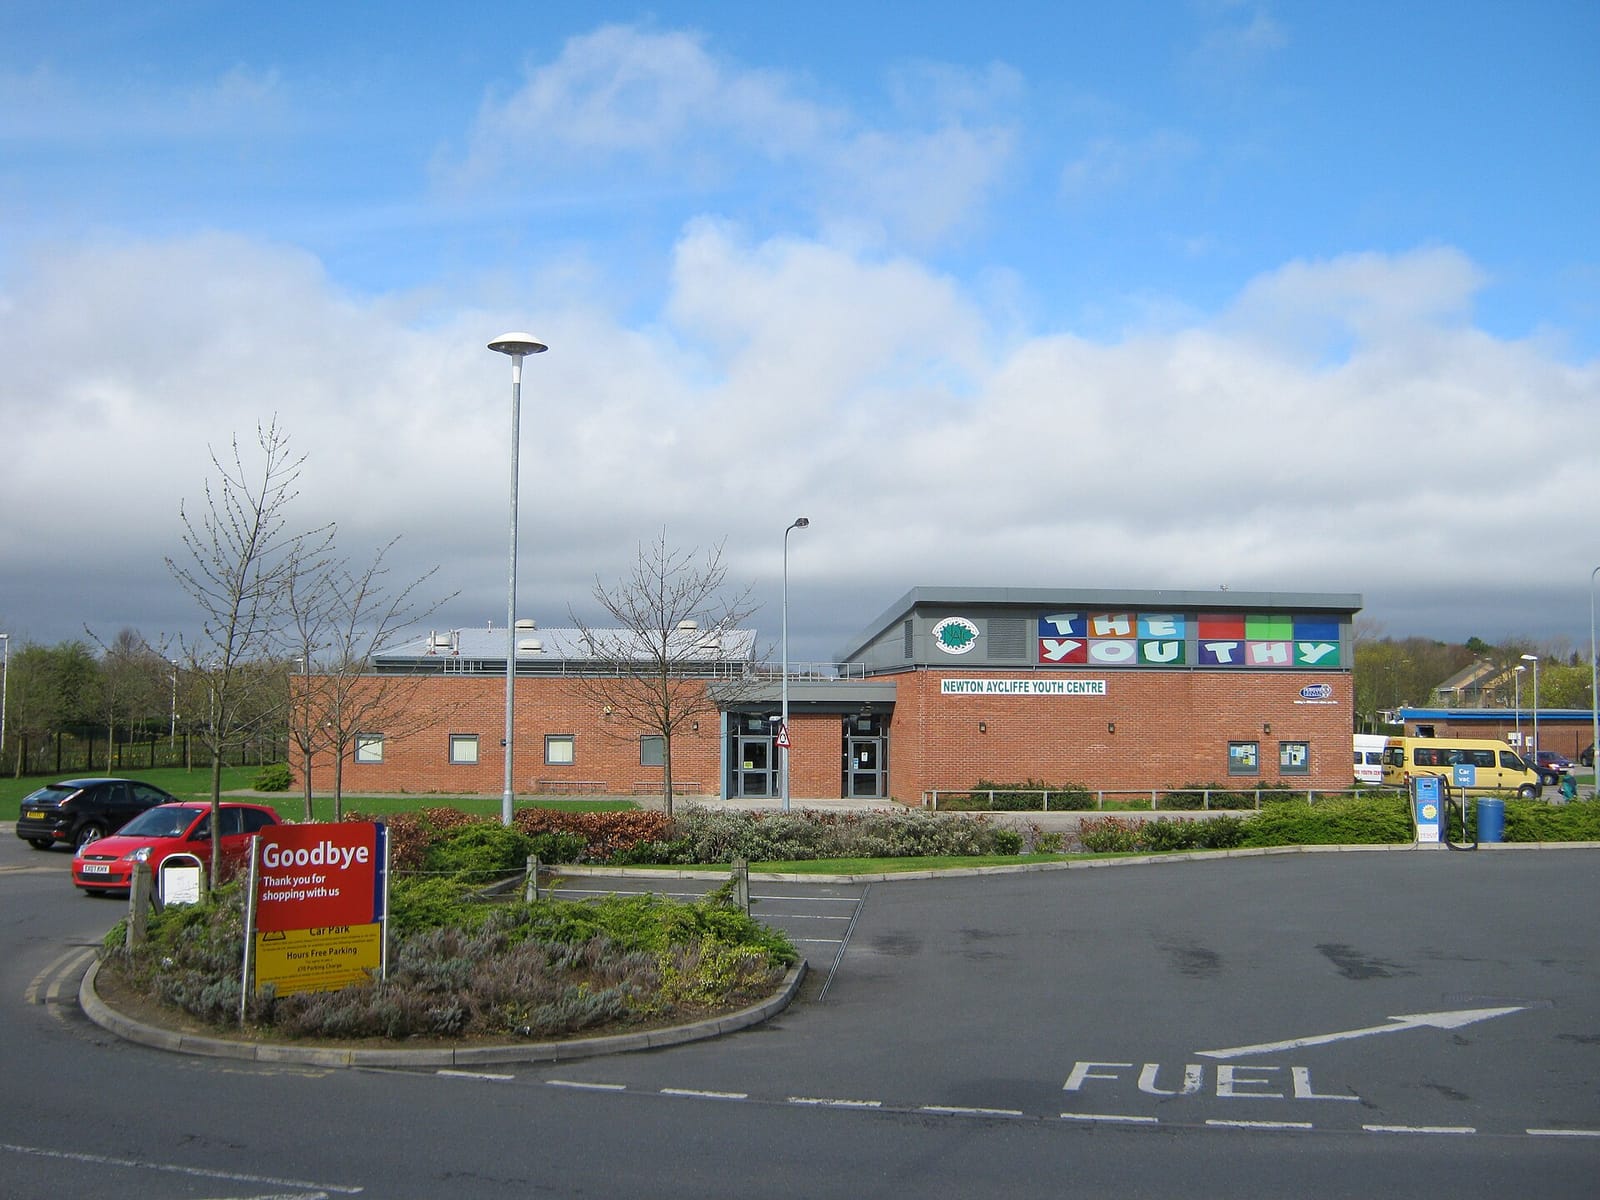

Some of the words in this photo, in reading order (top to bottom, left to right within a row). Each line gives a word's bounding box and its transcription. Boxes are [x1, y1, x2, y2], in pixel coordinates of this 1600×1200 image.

[1043, 613, 1177, 636] THE
[943, 680, 984, 692] NEWTON
[986, 681, 1029, 693] AYCLIFFE
[1032, 681, 1064, 693] YOUTH
[1066, 682, 1103, 693] CENTRE
[262, 840, 369, 870] Goodbye
[263, 875, 292, 886] Thank
[292, 876, 311, 888] you
[312, 873, 326, 884] for
[262, 888, 305, 902] shopping
[306, 887, 328, 898] with
[328, 888, 340, 897] us
[309, 926, 328, 936] Car
[329, 925, 350, 935] Park
[286, 951, 310, 961] Hours
[311, 949, 328, 957] Free
[328, 946, 358, 957] Parking
[306, 964, 324, 972] Parking
[324, 962, 343, 970] Charge
[1062, 1061, 1360, 1101] FUEL
